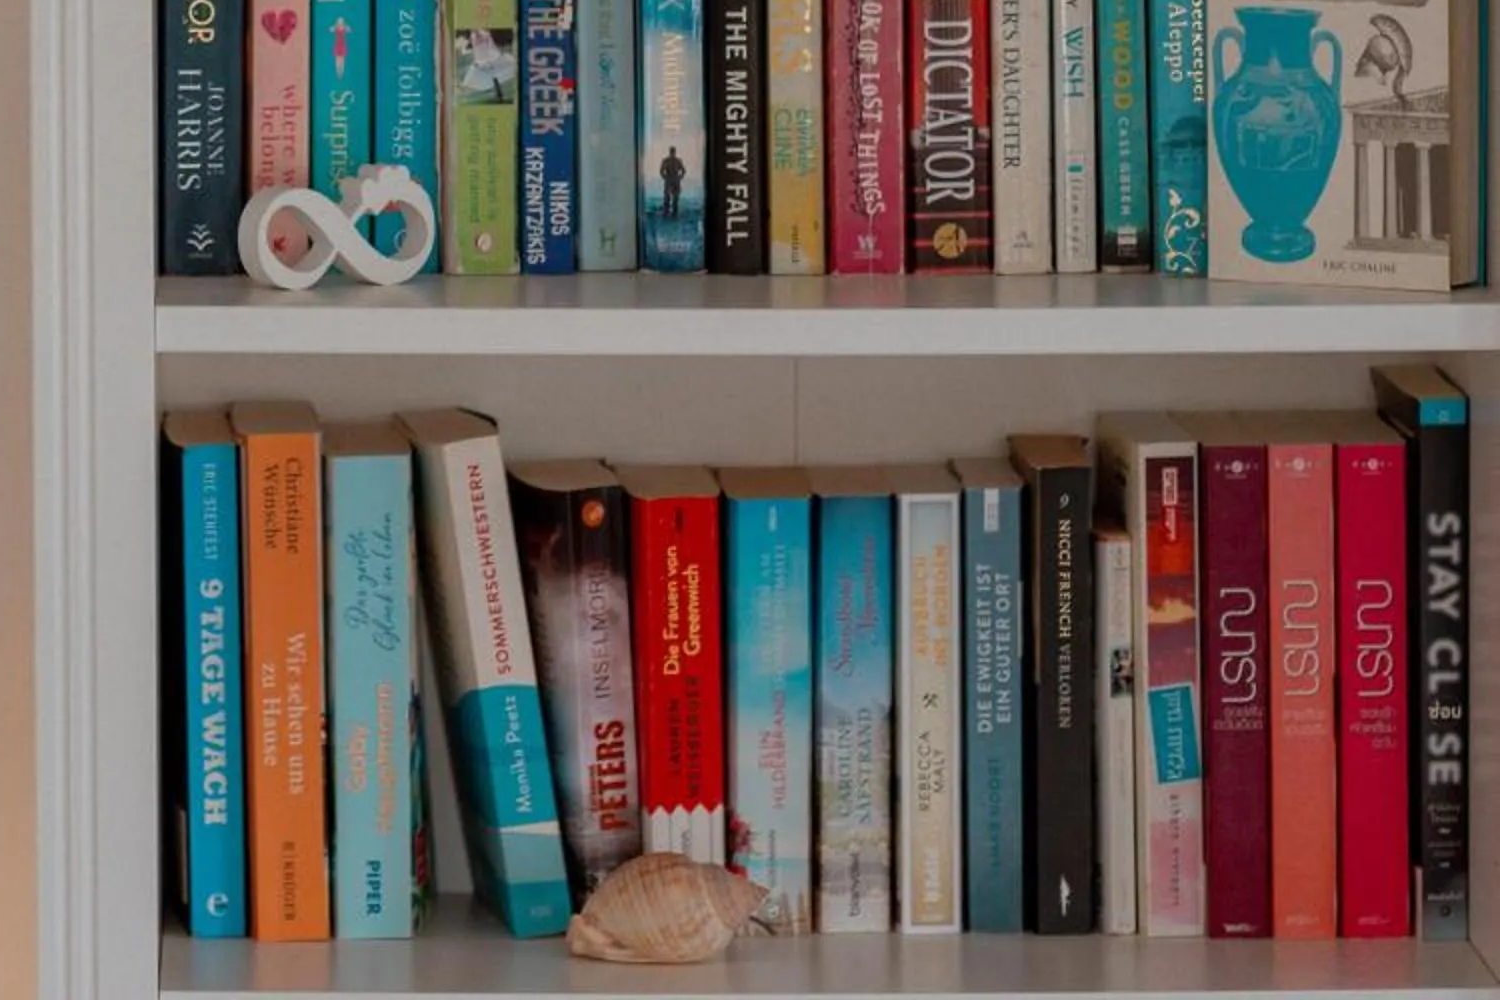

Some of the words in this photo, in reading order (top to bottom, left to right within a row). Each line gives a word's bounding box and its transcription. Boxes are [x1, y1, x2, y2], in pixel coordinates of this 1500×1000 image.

[398, 9, 421, 54] zoë
[725, 6, 747, 60] THE
[858, 39, 878, 64] OF
[1062, 26, 1085, 99] WISH
[1113, 20, 1133, 109] WOOD
[1164, 2, 1188, 82] Aleppo
[281, 85, 303, 158] where
[392, 65, 422, 159] folbigg
[529, 47, 564, 136] GREEK
[725, 70, 748, 174] MIGHTY
[859, 72, 882, 123] LOST
[923, 18, 975, 204] DICTATOR
[1002, 47, 1021, 169] DAUGHTER
[177, 69, 203, 191] HARRIS
[207, 82, 225, 176] JOANNE
[257, 105, 280, 188] belong
[525, 147, 545, 264] KAZANTZAKIS
[549, 181, 570, 235] NIKOS
[857, 130, 886, 216] THINGS
[726, 184, 748, 247] FALL
[263, 464, 282, 550] Wünsche
[283, 457, 303, 554] Christiane
[466, 463, 512, 675] SOMMERSCHWESTERN
[665, 546, 679, 576] von
[976, 563, 991, 593] IST
[1058, 519, 1071, 566] NICCI
[1427, 512, 1461, 620] STAY
[199, 578, 225, 599] 9
[662, 582, 680, 640] Frauen
[682, 564, 702, 656] Greenwich
[994, 572, 1010, 613] ORT
[1058, 572, 1071, 638] FRENCH
[200, 605, 225, 704] TAGE
[261, 662, 277, 689] zu
[285, 632, 307, 676] Wir
[663, 645, 681, 675] Die
[976, 599, 993, 694] EWIGKEIT
[995, 618, 1011, 683] GUTER
[286, 682, 308, 746] sehen
[503, 694, 523, 744] Peetz
[976, 698, 993, 734] DIE
[995, 688, 1011, 724] EIN
[1058, 643, 1071, 729] VERLOREN
[203, 710, 227, 825] WACH
[261, 697, 280, 767] Hause
[835, 715, 853, 817] CAROLINE
[288, 755, 306, 795] uns
[510, 749, 533, 813] Monika
[594, 720, 634, 832] PETERS
[916, 731, 932, 812] REBECCA
[931, 749, 946, 794] MALY
[365, 860, 381, 916] PIPER
